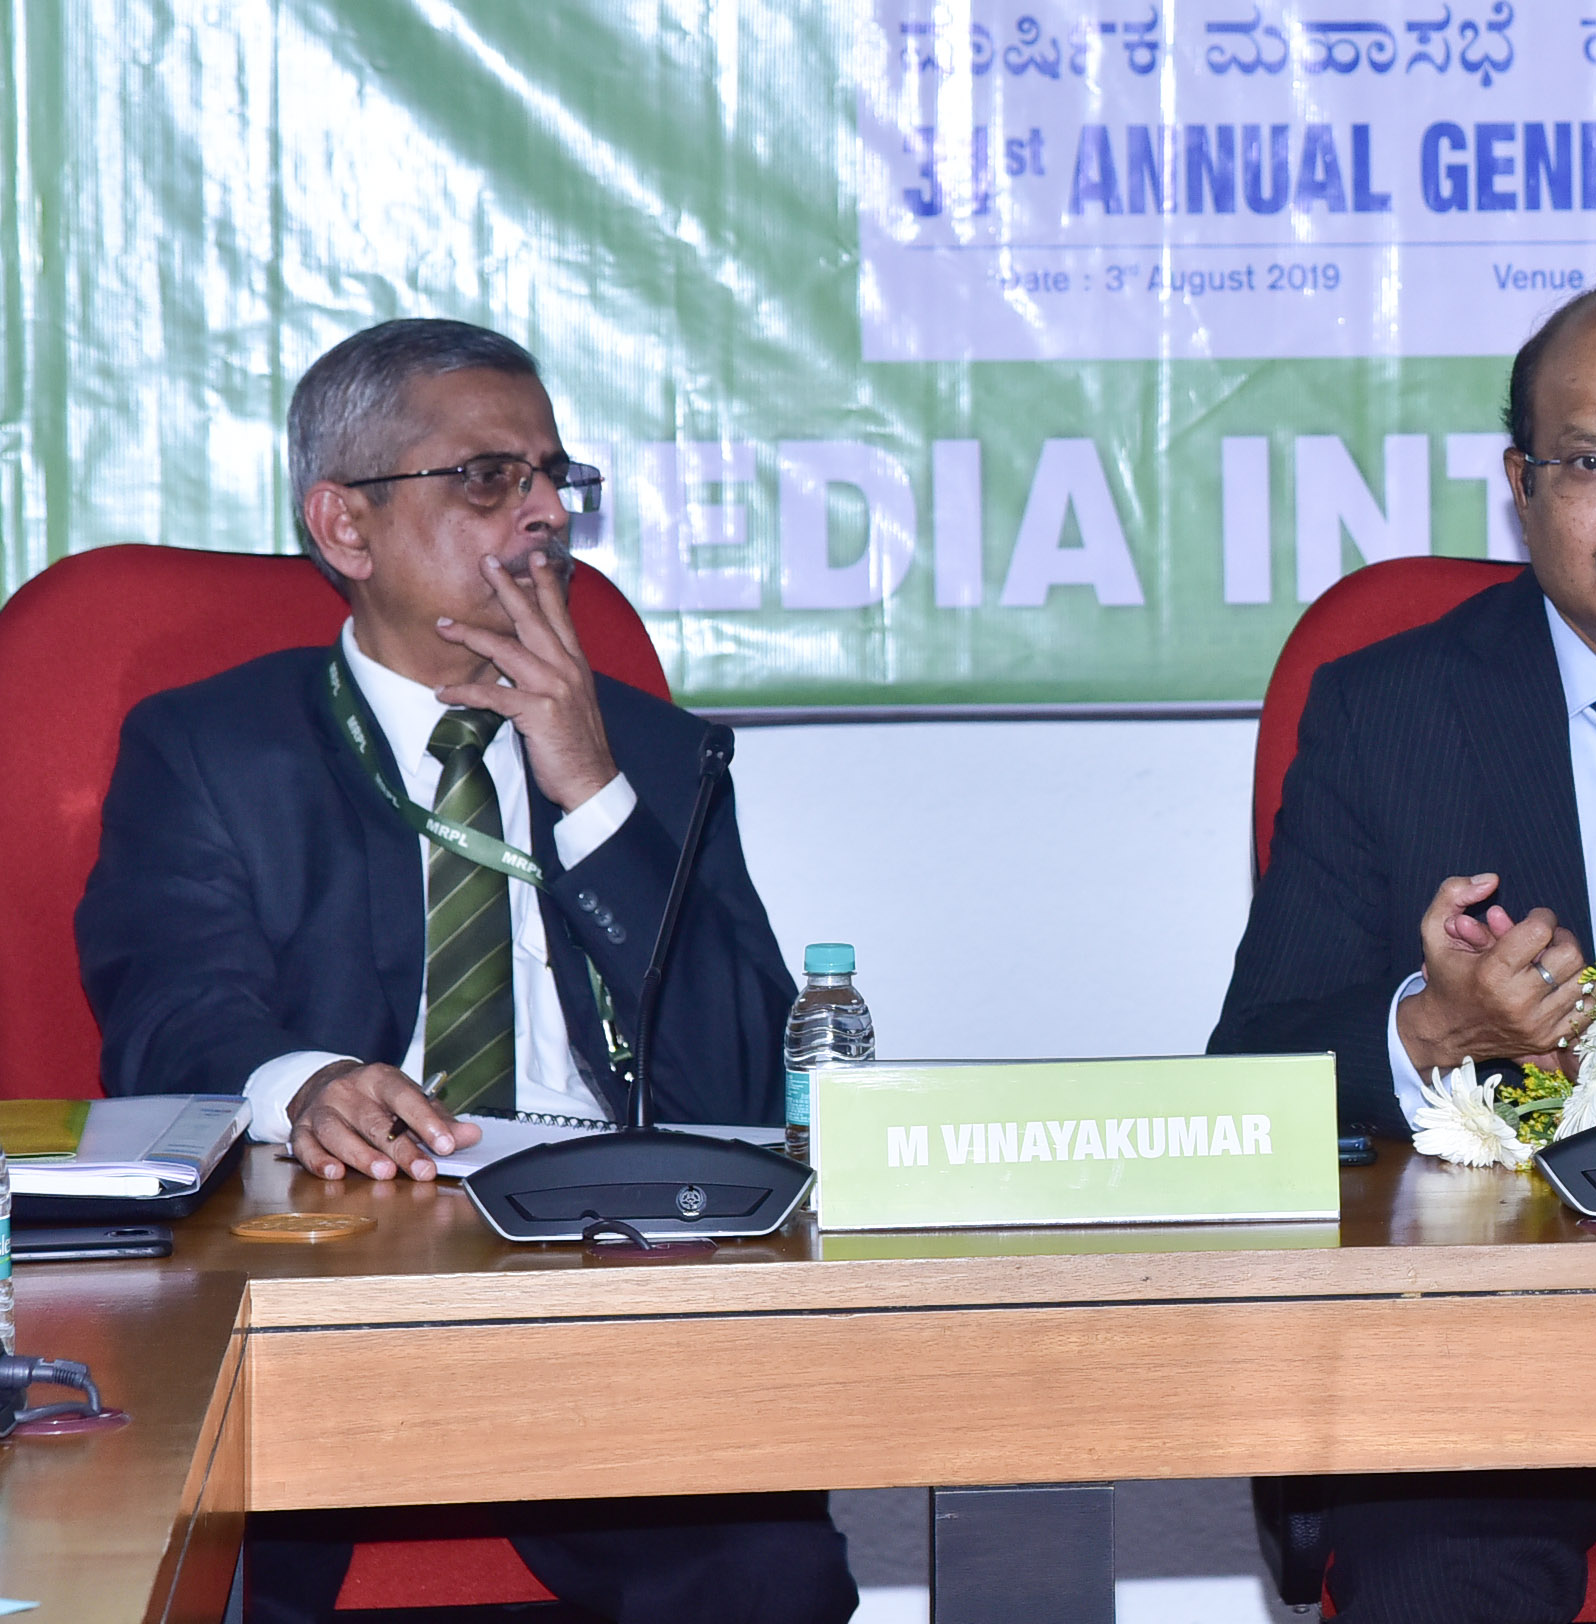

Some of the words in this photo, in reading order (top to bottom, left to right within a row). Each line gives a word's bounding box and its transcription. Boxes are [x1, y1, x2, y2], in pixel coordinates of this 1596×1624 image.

[1205, 0, 1514, 88] ಮಹಾಸಭೆ
[1068, 123, 1391, 215] ANNUAL
[1148, 264, 1255, 297] August
[1267, 263, 1340, 291] 2019
[1493, 263, 1585, 290] Venue
[425, 818, 469, 849] MRPL
[501, 851, 544, 881] MRPL
[887, 1125, 929, 1167] M
[941, 1114, 1273, 1165] VINAYAKUMAR
